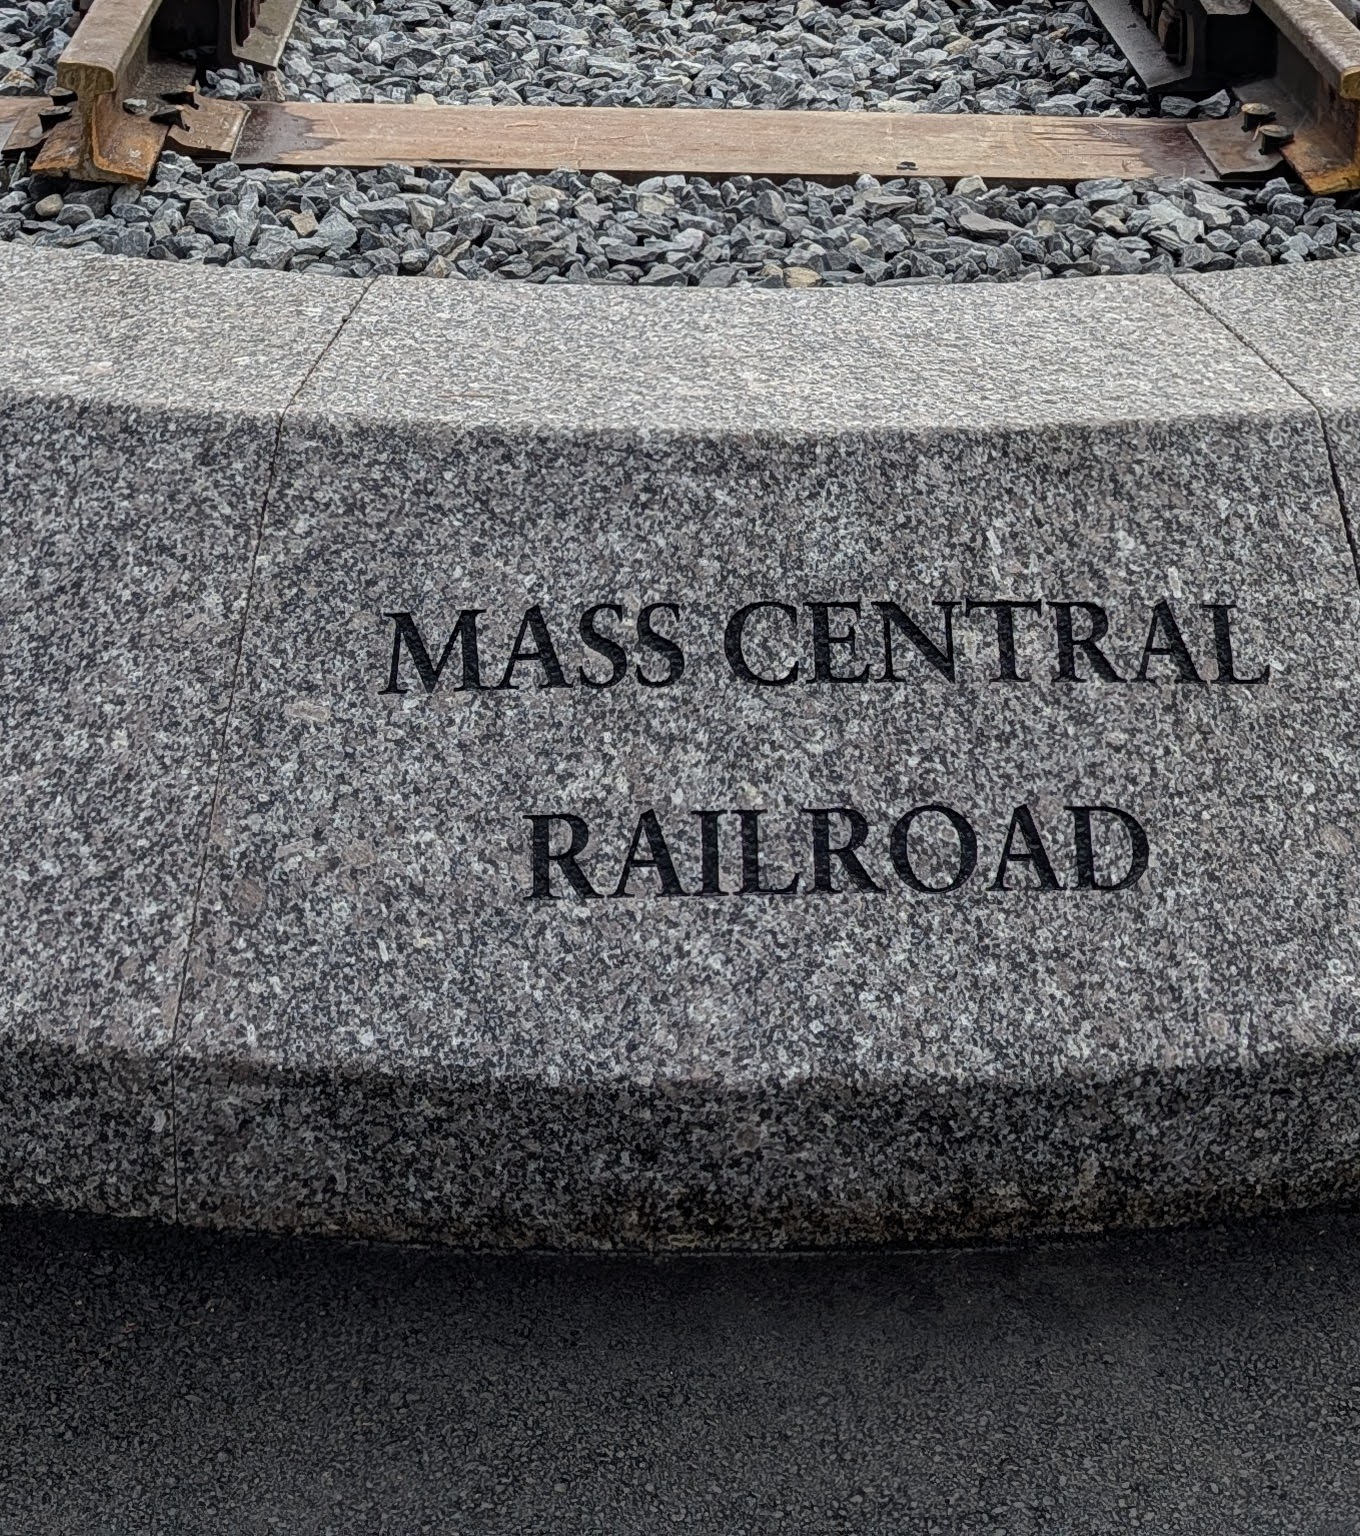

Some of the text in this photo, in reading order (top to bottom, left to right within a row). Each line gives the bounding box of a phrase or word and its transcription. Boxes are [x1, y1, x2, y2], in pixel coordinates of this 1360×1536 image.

[378, 597, 1271, 695] MASS CENTRAL
[523, 803, 1151, 901] RAILROAD
